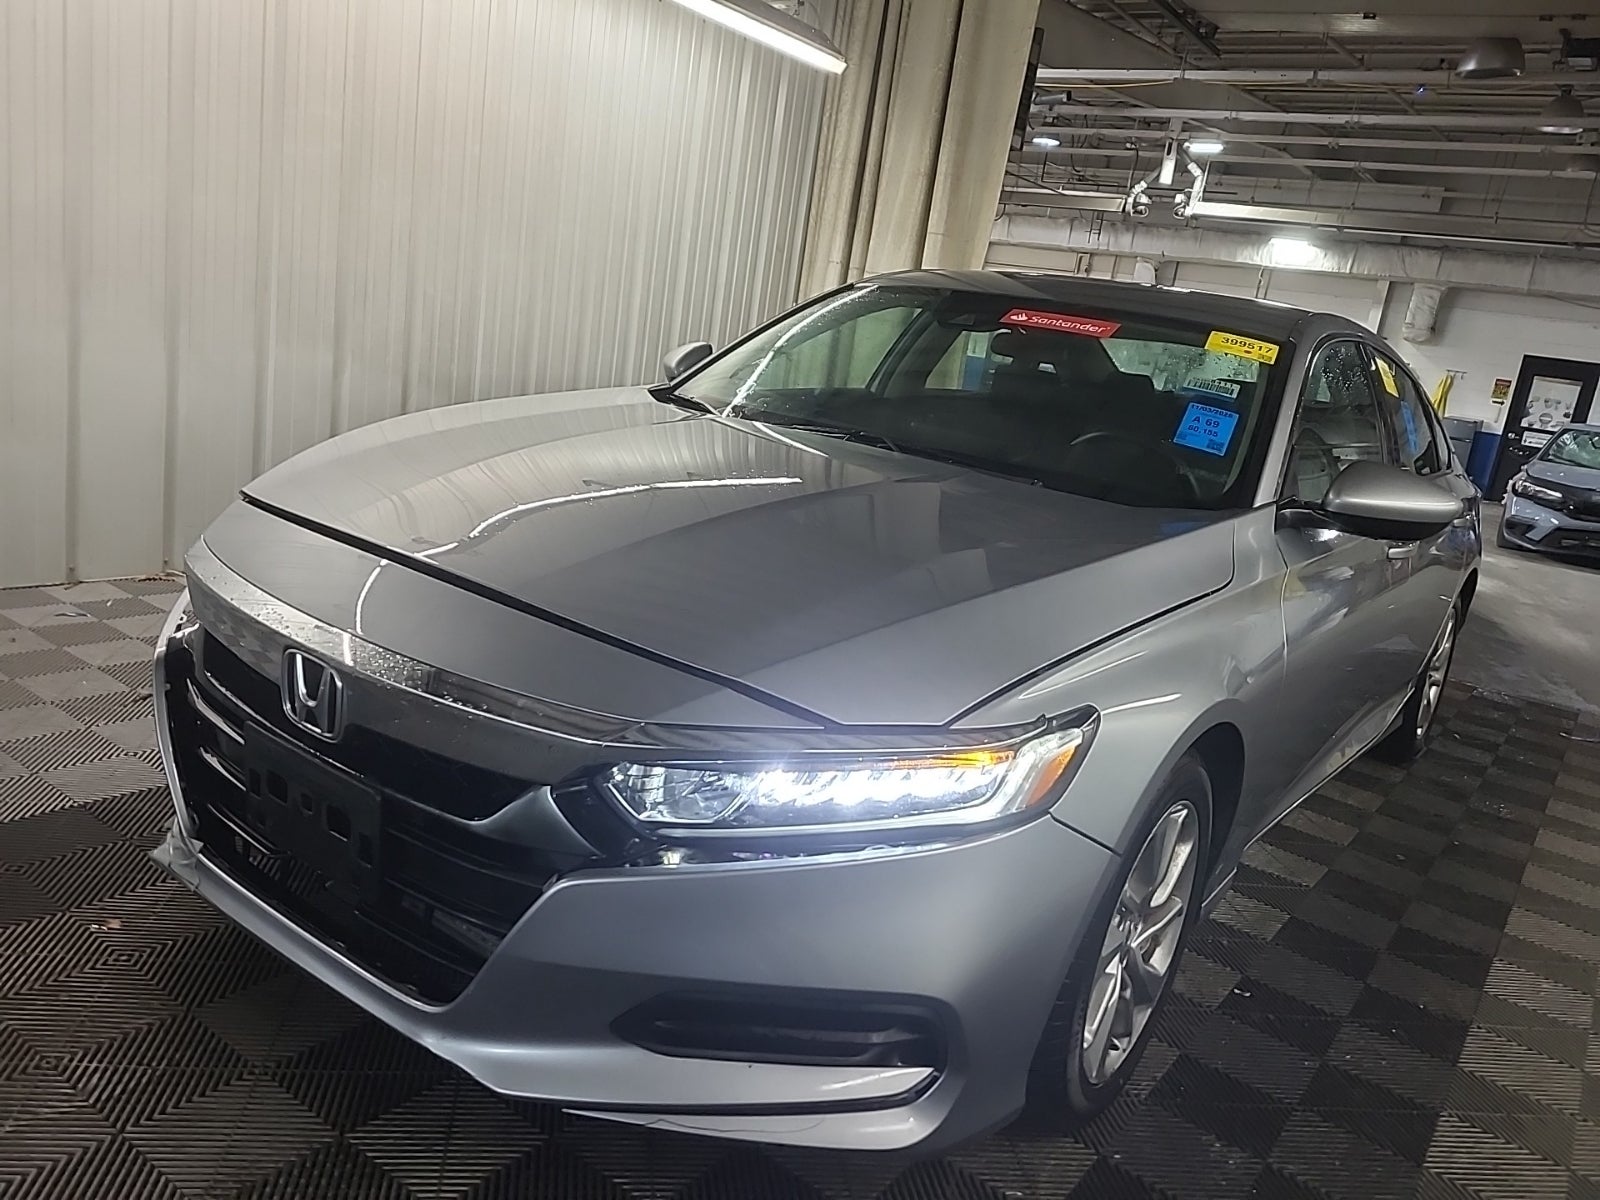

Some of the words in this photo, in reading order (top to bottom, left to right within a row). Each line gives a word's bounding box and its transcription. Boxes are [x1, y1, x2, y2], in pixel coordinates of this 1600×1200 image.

[1029, 316, 1106, 333] Santander
[1221, 336, 1273, 354] 399517
[1192, 415, 1201, 424] A
[1205, 418, 1220, 428] 69
